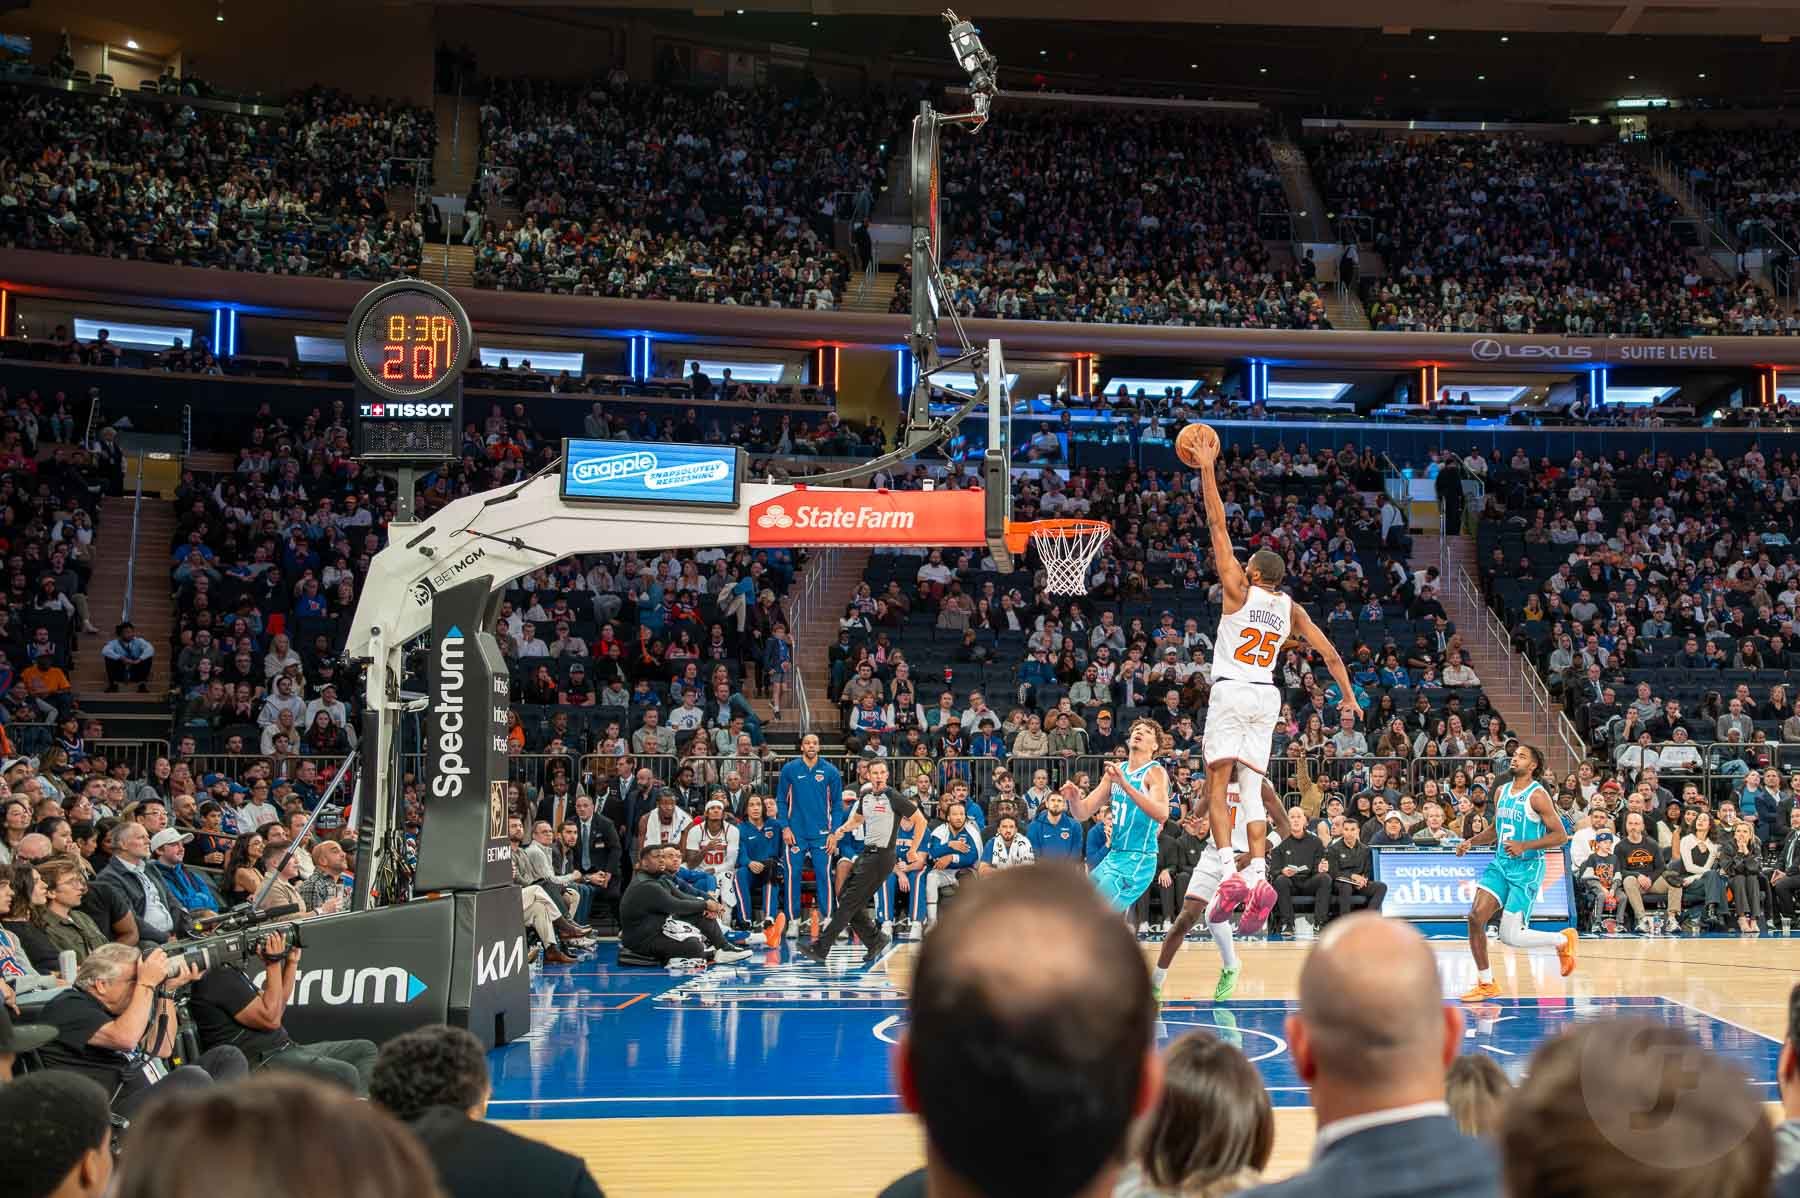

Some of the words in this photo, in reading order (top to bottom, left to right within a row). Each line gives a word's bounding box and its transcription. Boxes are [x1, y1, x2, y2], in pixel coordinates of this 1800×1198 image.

[1505, 347, 1592, 358] LEXUS
[1621, 346, 1664, 359] SUITE
[1671, 347, 1716, 359] LEVEL
[386, 403, 453, 417] TISSOT
[579, 455, 650, 478] snapple
[1249, 609, 1285, 631] BRIDGES
[1234, 627, 1280, 667] 25
[432, 637, 471, 798] Spectrum
[487, 846, 511, 862] BETMGM
[1396, 865, 1475, 879] experience
[1393, 881, 1452, 904] abu
